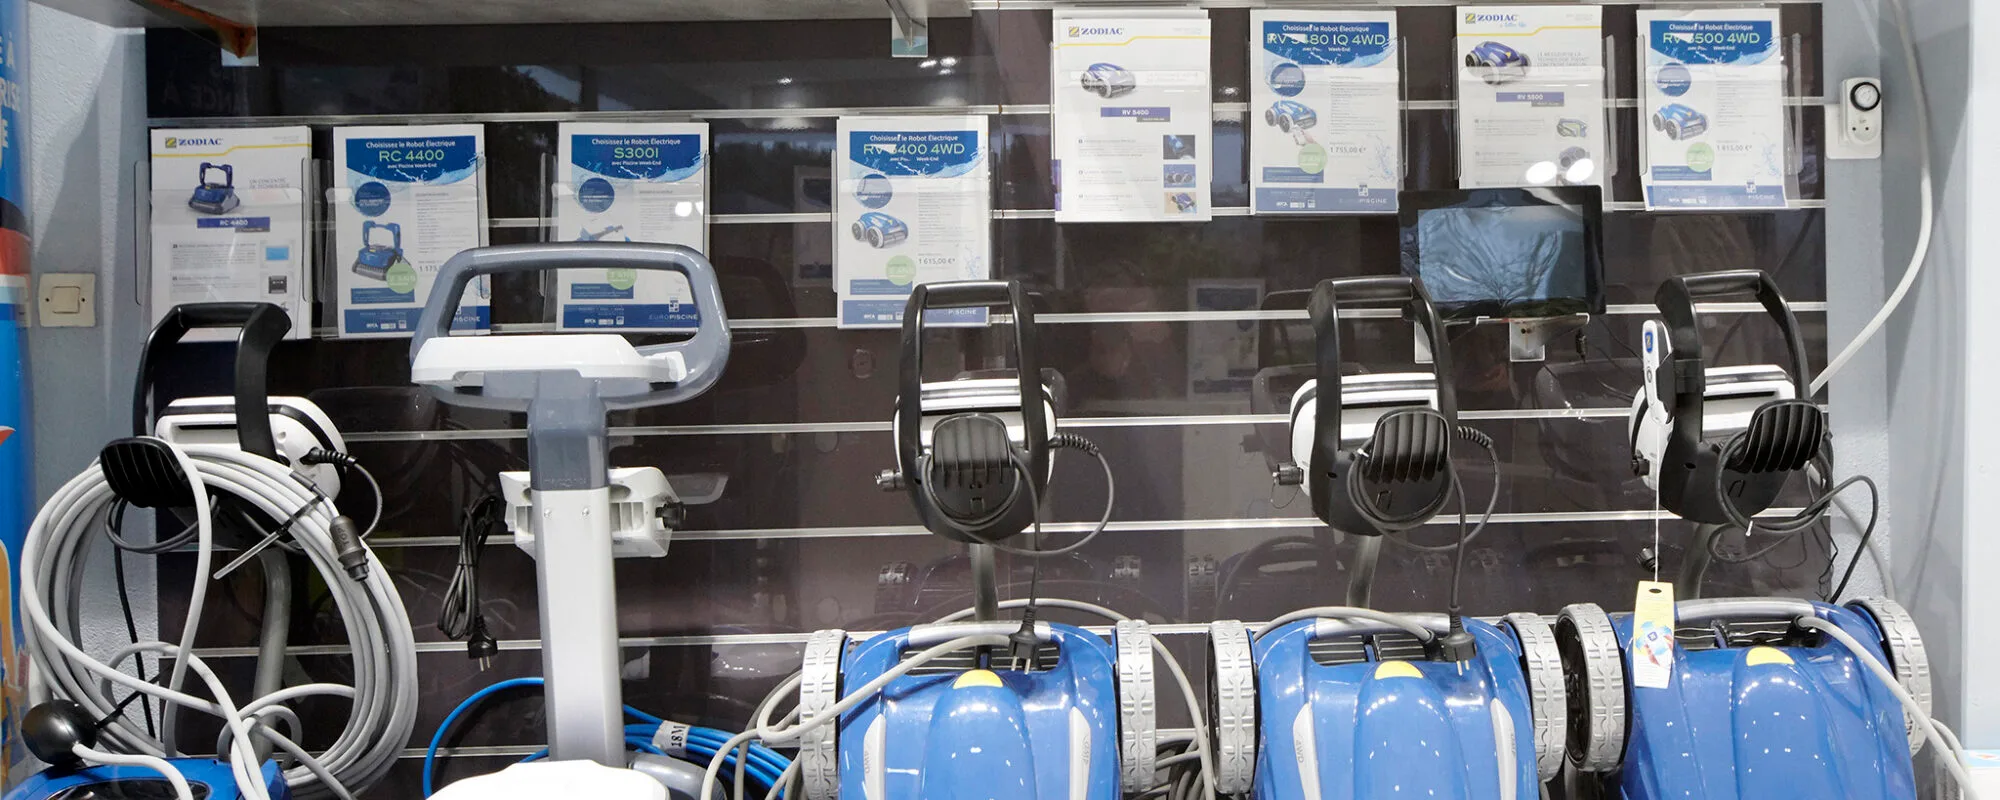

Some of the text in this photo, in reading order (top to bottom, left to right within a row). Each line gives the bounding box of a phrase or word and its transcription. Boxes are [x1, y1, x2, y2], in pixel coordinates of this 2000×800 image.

[1340, 24, 1369, 32] Électrique
[1724, 24, 1754, 32] Électrique
[1290, 34, 1329, 44] 80
[1333, 34, 1348, 46] IQ
[1352, 34, 1386, 45] 4WD
[1686, 33, 1724, 44] 500
[1727, 33, 1760, 44] 4WD
[928, 134, 958, 142] Électrique
[426, 140, 456, 148] Électrique
[888, 144, 927, 155] 400
[931, 144, 965, 155] 4WD
[379, 150, 444, 162] RC 4400
[671, 725, 686, 748] 18M
[1296, 740, 1304, 764] 4WD
